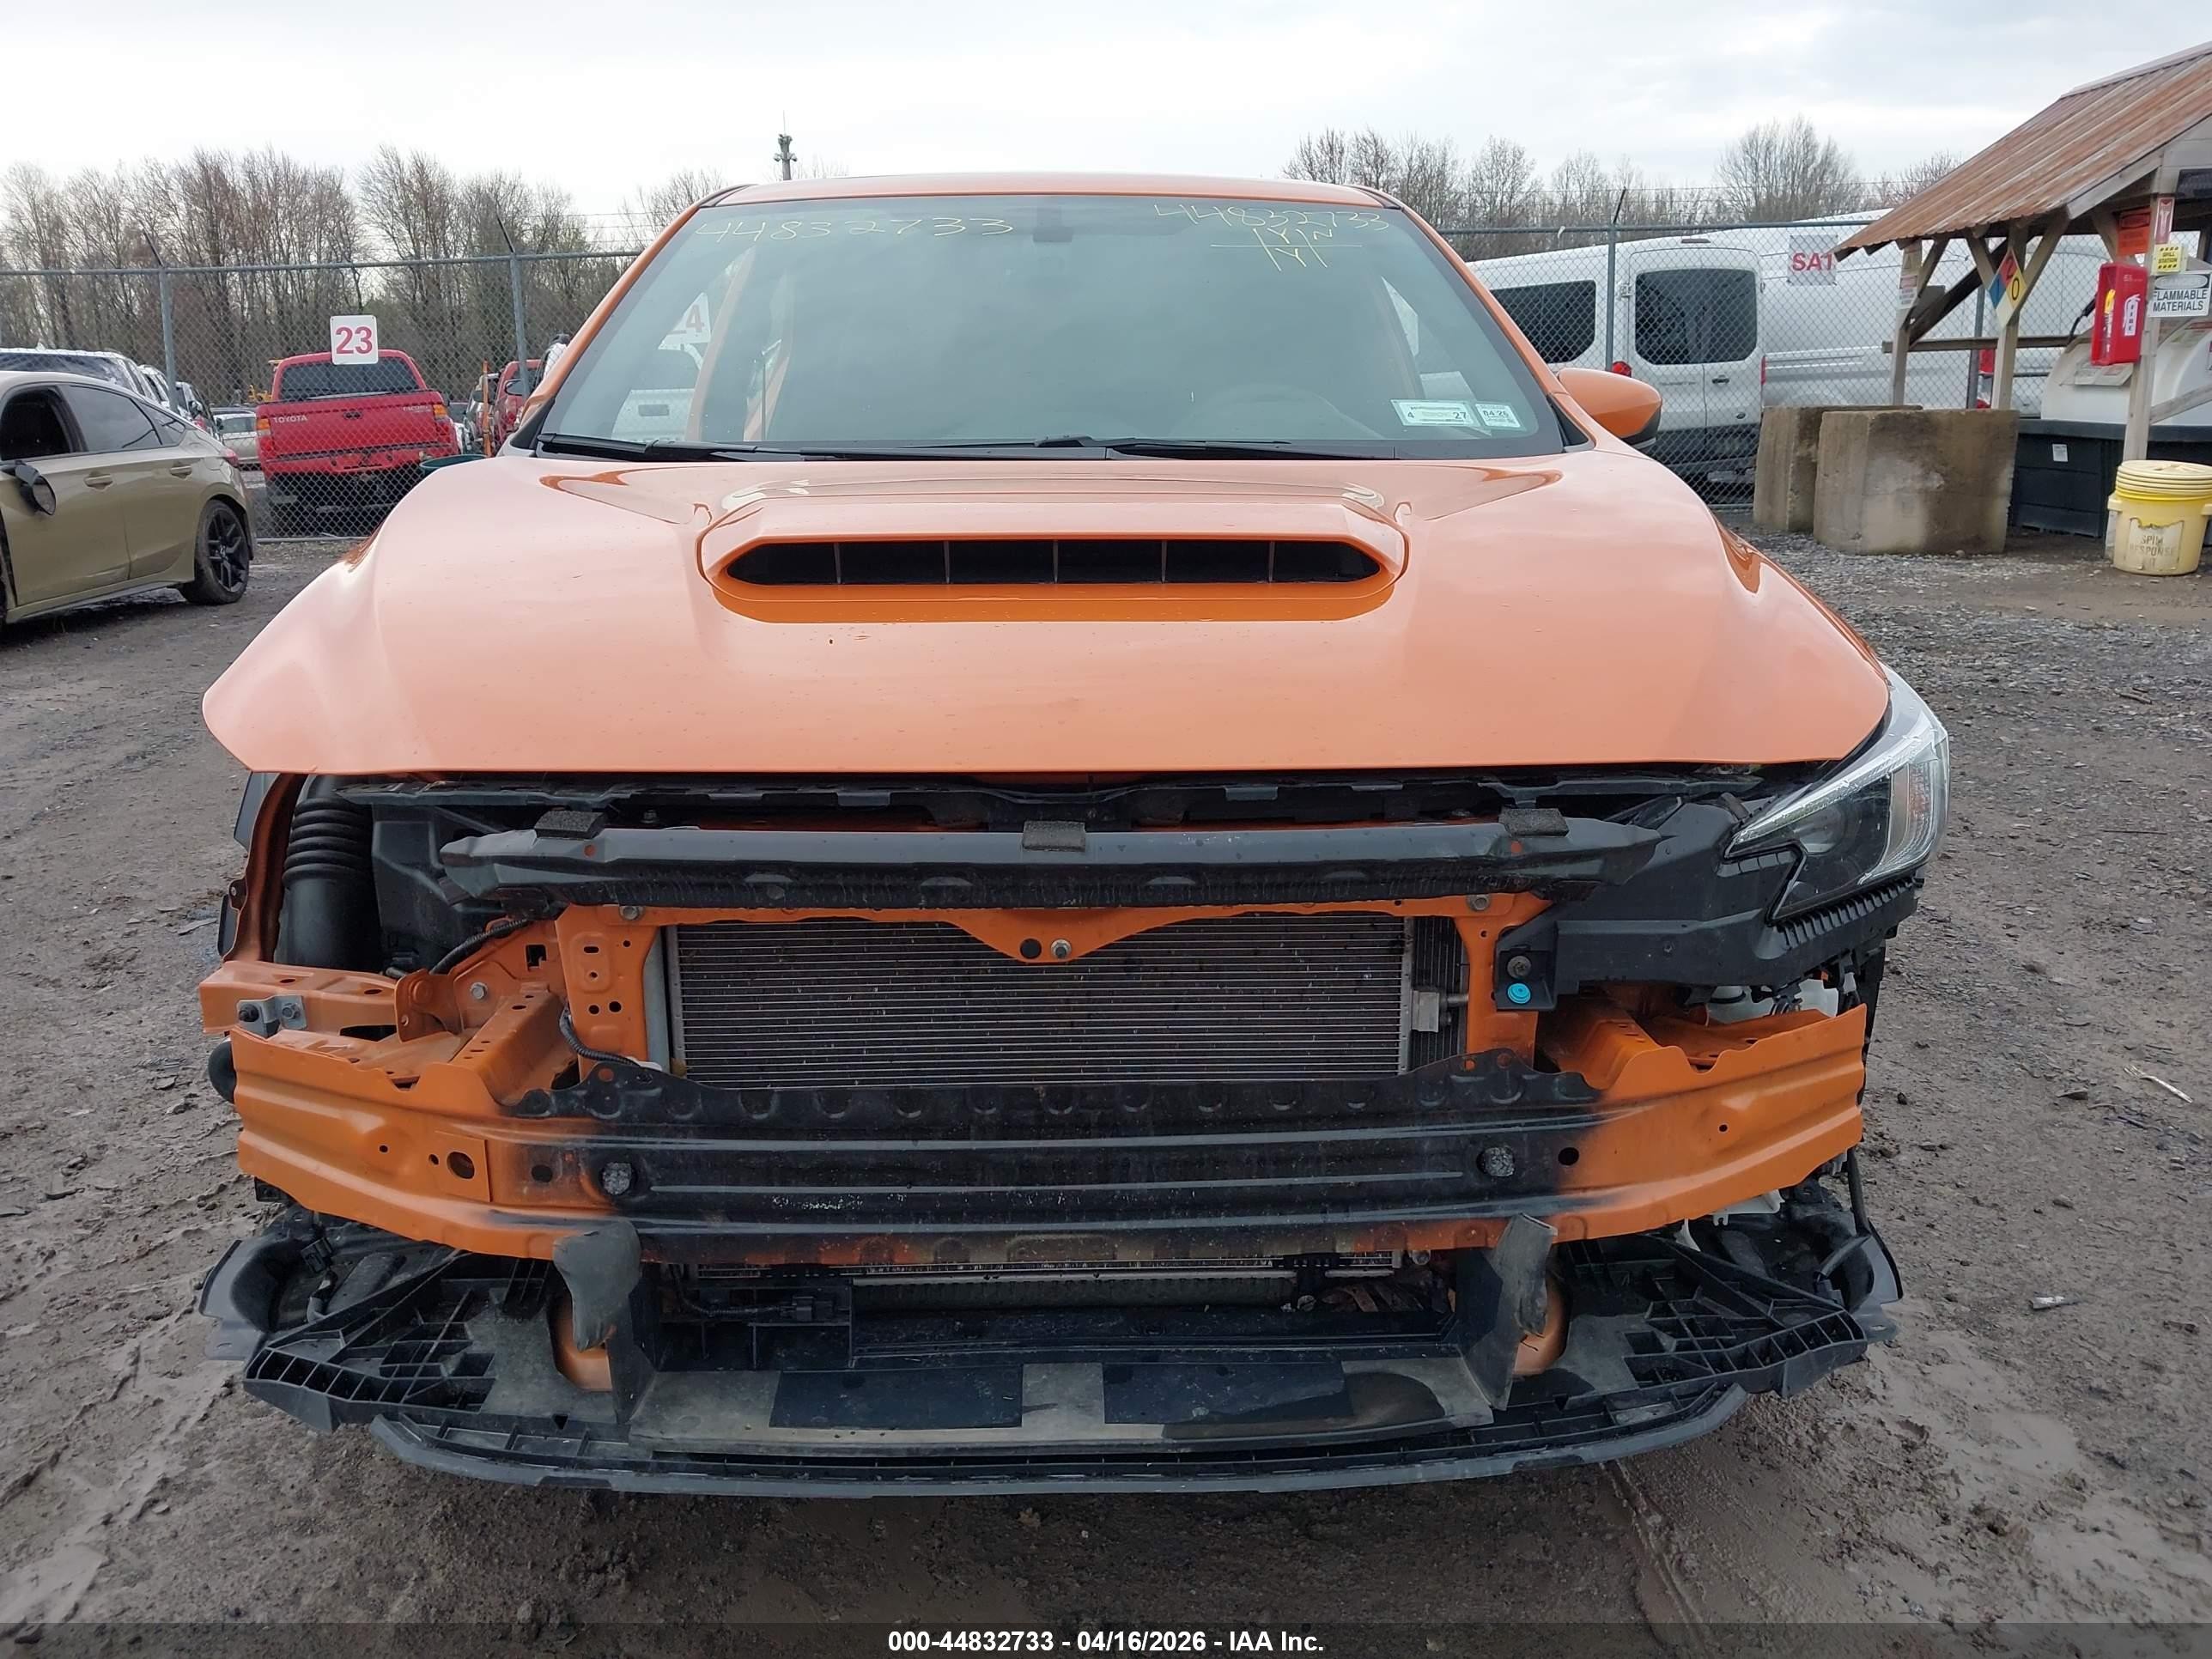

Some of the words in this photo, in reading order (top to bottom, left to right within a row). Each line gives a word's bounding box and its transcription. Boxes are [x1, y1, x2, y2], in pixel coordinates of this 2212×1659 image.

[1154, 204, 1389, 230] 44832733
[696, 218, 1013, 242] 44832733
[2153, 301, 2203, 312] MATERIALS
[336, 326, 373, 354] 23
[273, 415, 307, 423] TOYOTA
